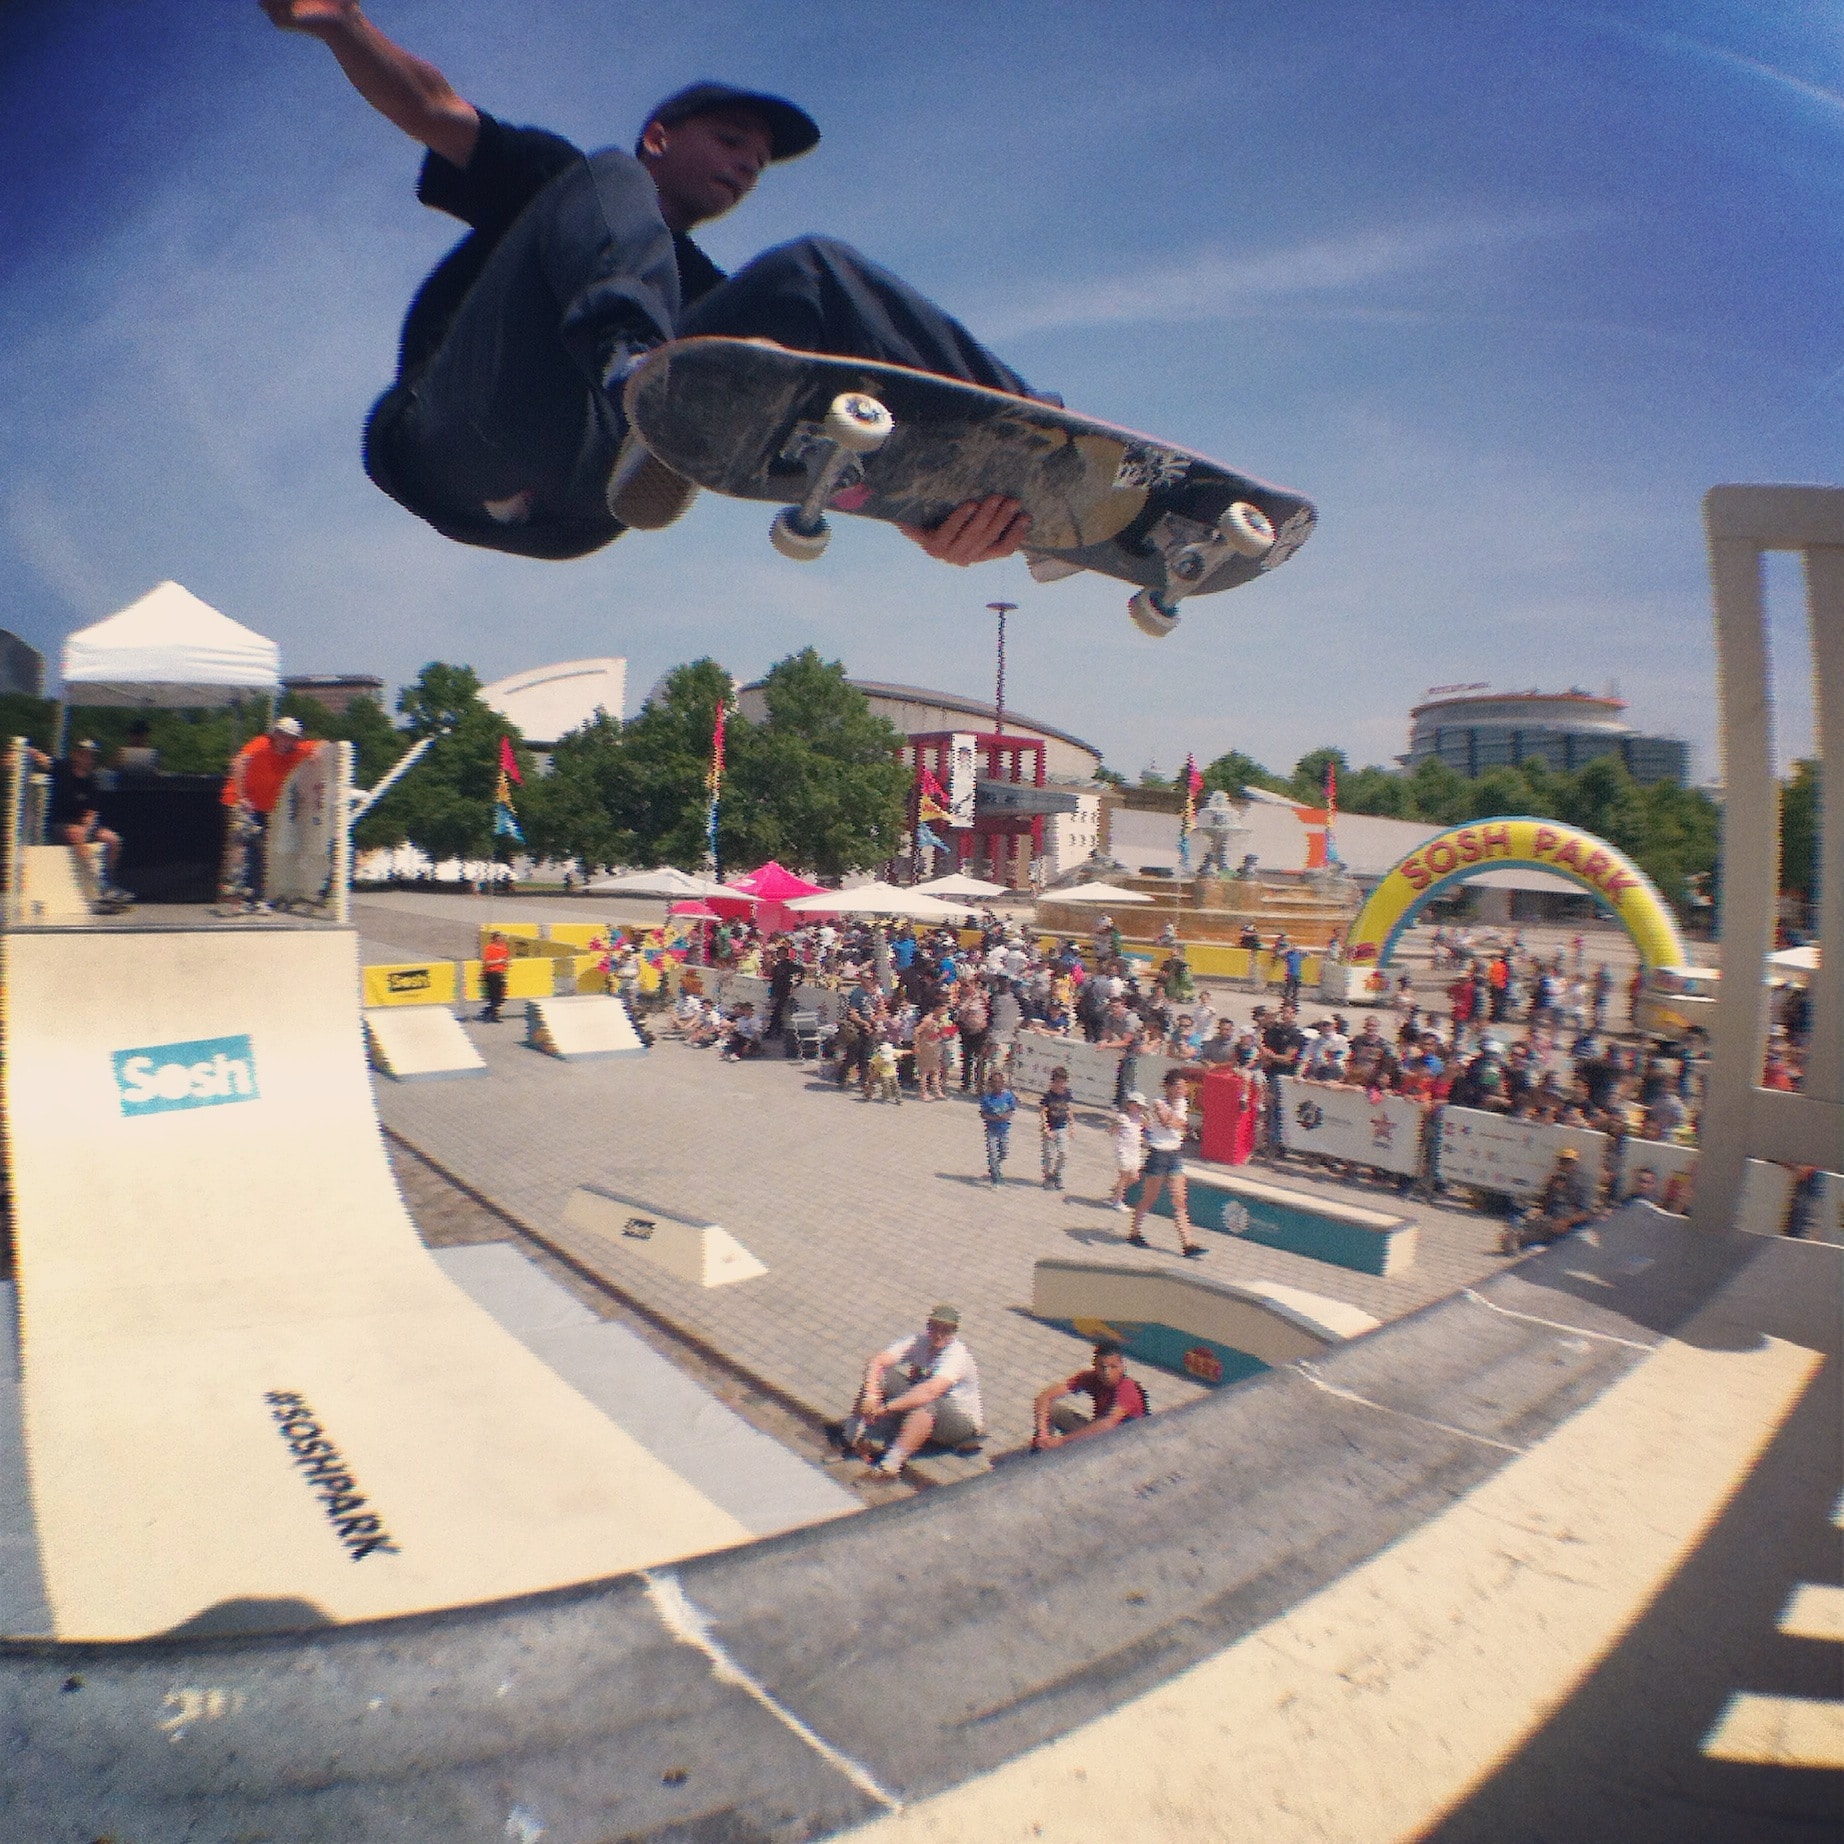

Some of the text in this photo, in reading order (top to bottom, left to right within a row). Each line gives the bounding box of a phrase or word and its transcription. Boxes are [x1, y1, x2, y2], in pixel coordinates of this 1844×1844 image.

[1401, 824, 1641, 903] SOSH PARK
[122, 1053, 252, 1103] Sosh
